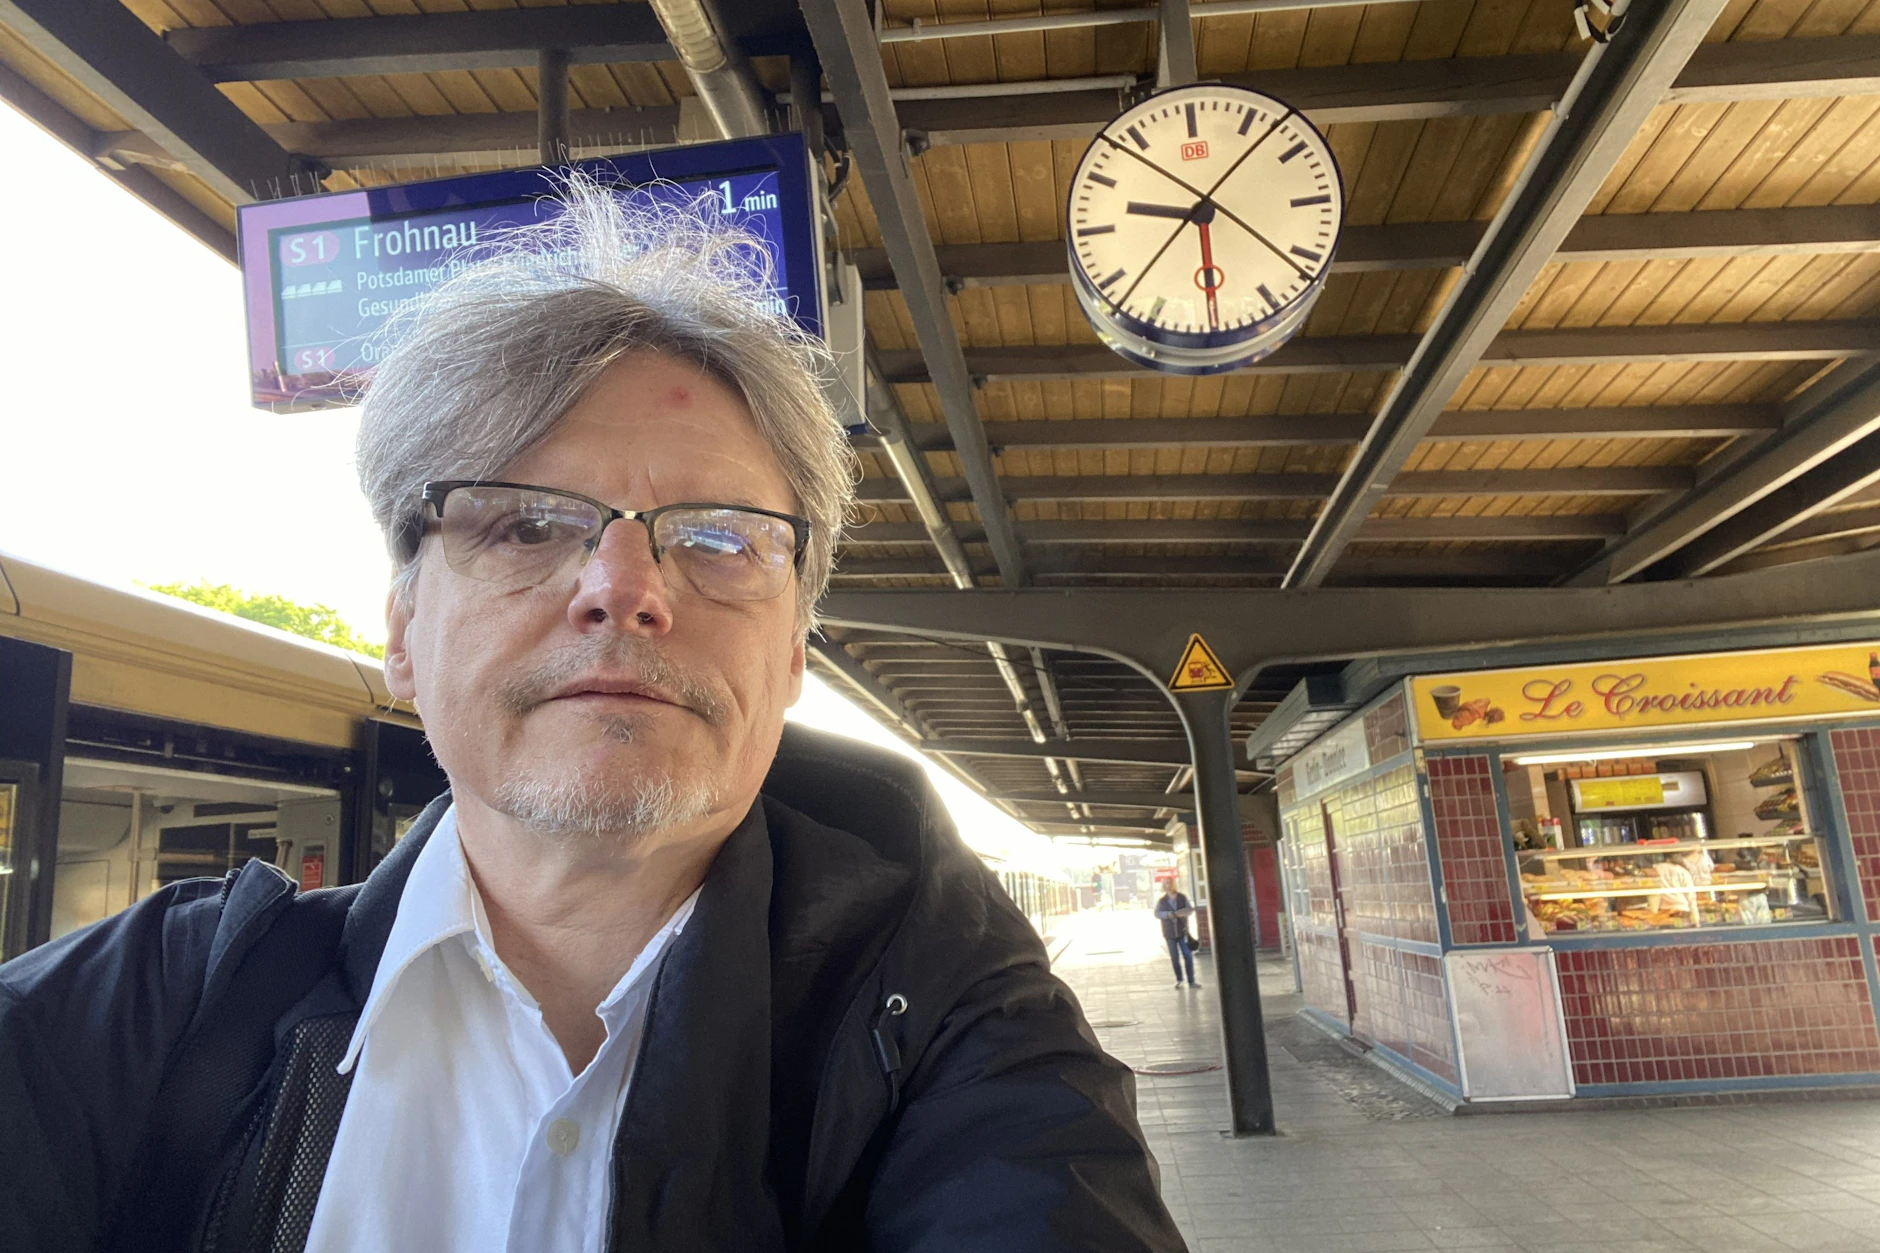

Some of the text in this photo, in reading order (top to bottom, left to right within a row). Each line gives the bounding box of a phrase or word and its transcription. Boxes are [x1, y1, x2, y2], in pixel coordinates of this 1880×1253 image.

[1183, 143, 1206, 158] DB
[718, 180, 778, 214] 1 min
[353, 219, 478, 260] Frohnau
[356, 266, 445, 291] Potsdamer
[1519, 671, 1798, 722] Le Croissant
